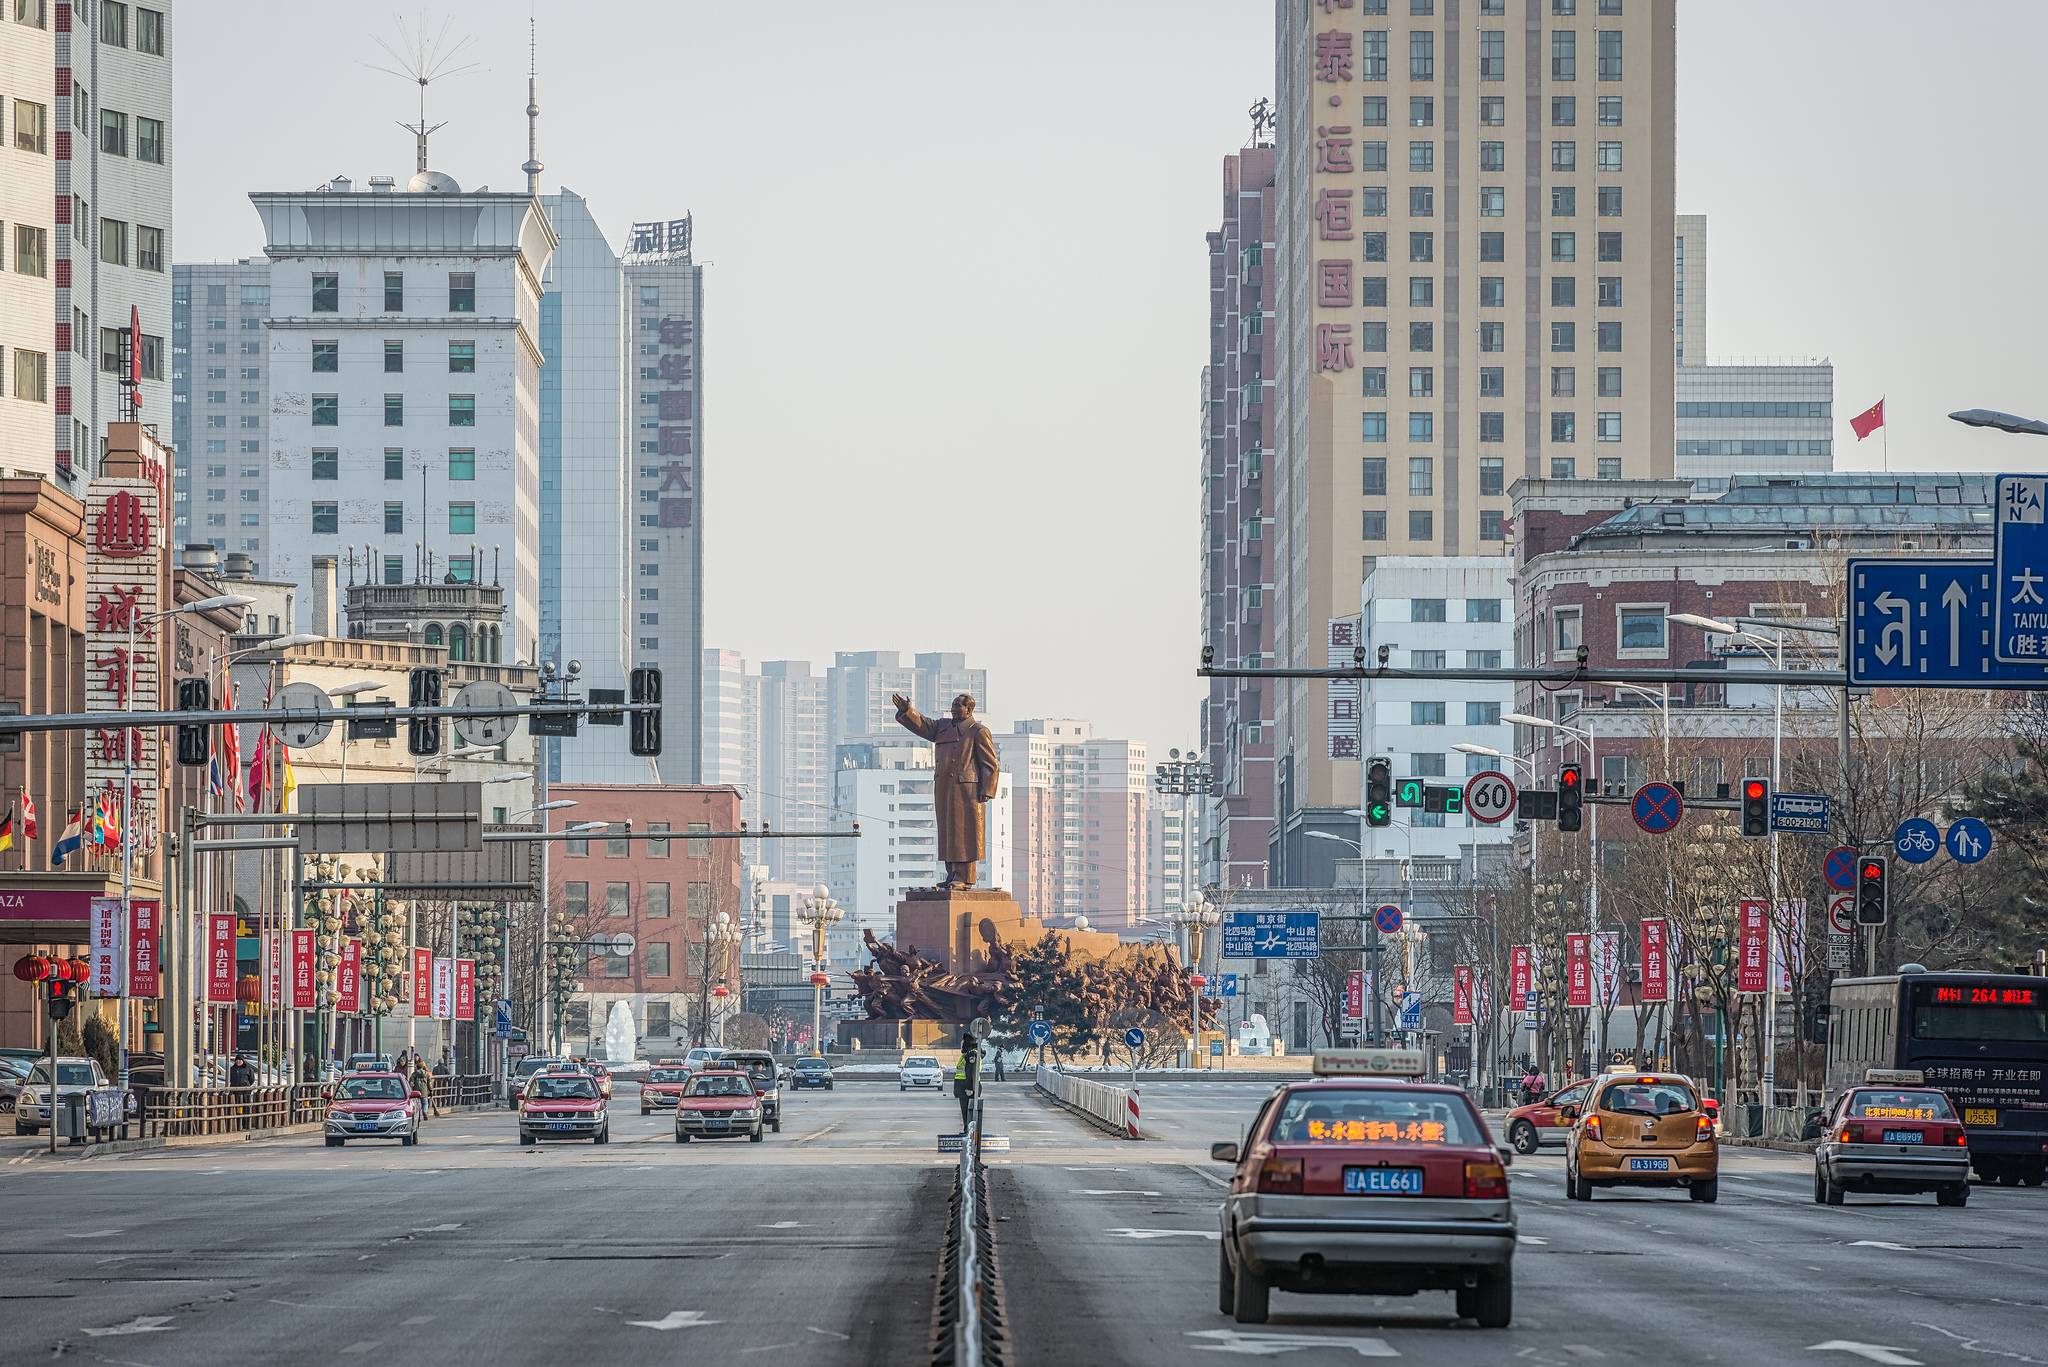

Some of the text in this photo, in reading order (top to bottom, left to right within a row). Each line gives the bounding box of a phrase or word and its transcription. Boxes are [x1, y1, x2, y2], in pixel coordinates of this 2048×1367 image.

[2006, 482, 2027, 504] 北
[2009, 508, 2022, 521] N
[2011, 567, 2044, 605] 太
[2013, 613, 2048, 629] TAIYU
[1446, 787, 1461, 812] 2
[1474, 783, 1507, 809] 60
[1778, 817, 1821, 828] 6:00-21:00
[1256, 914, 1287, 924] 南京街
[1225, 926, 1316, 936] 北四马路 中山路
[1225, 942, 1318, 951] 中山路 北四马路
[1971, 988, 1997, 1003] 264
[1924, 1066, 1986, 1080] 全球招商中
[1992, 1069, 2041, 1081] 开业在即
